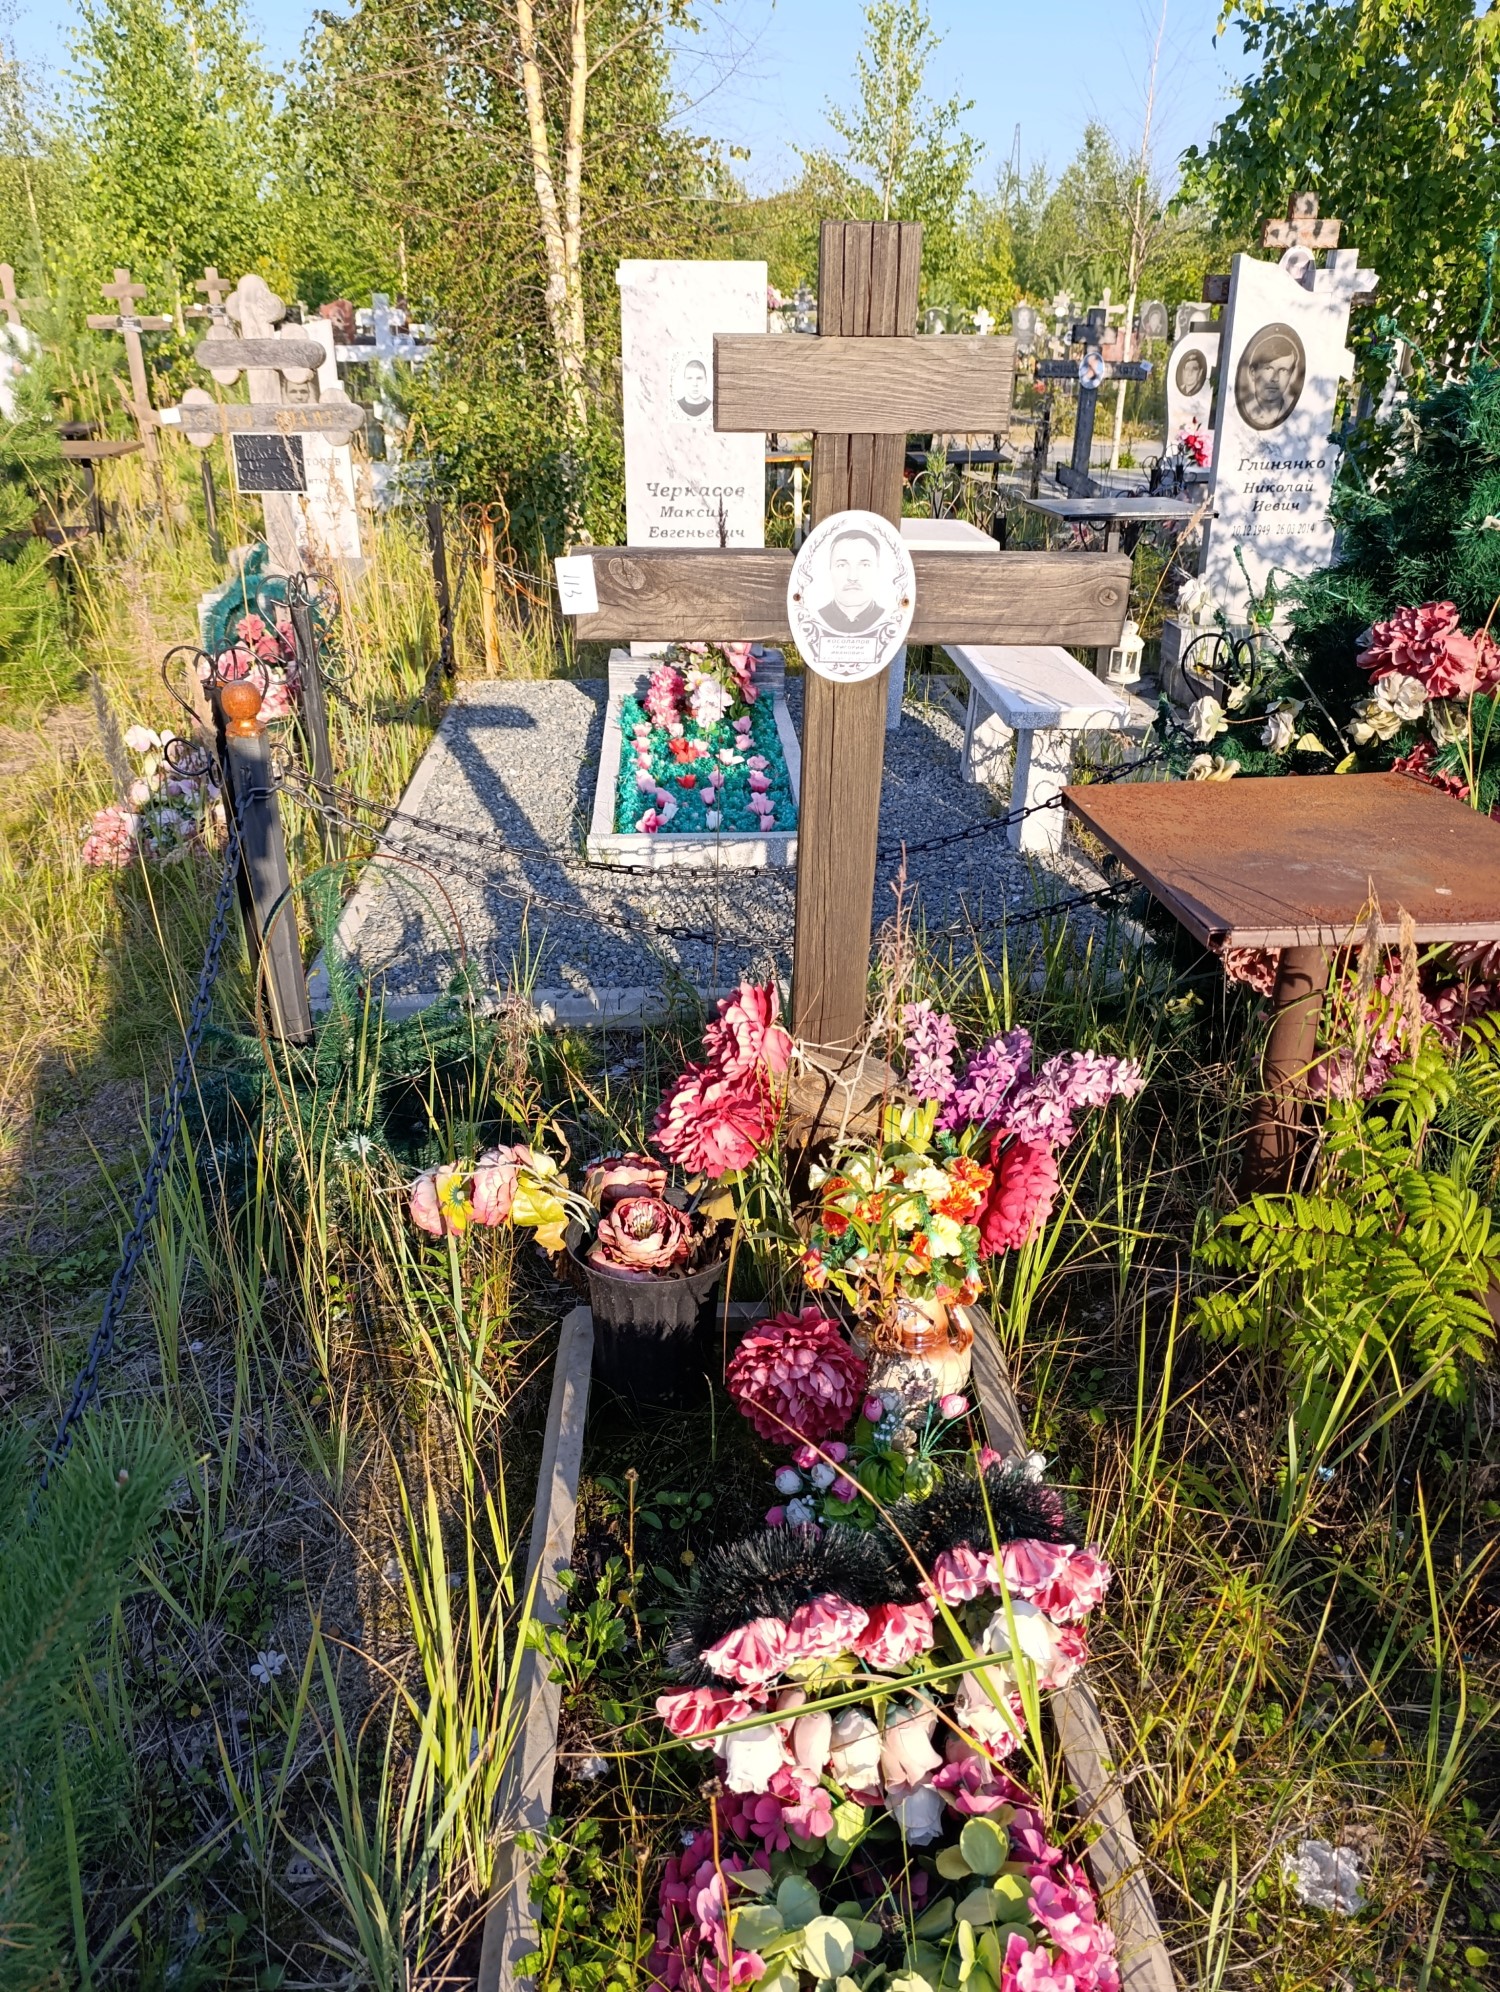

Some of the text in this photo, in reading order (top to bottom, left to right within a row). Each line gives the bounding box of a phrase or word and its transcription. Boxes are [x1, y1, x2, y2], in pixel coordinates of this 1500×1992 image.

[1237, 458, 1326, 472] Глинянко
[646, 482, 745, 502] Черкасов
[1243, 479, 1314, 494] Николай
[1251, 500, 1301, 513] Иевич
[1231, 524, 1271, 537] 10.12.1949
